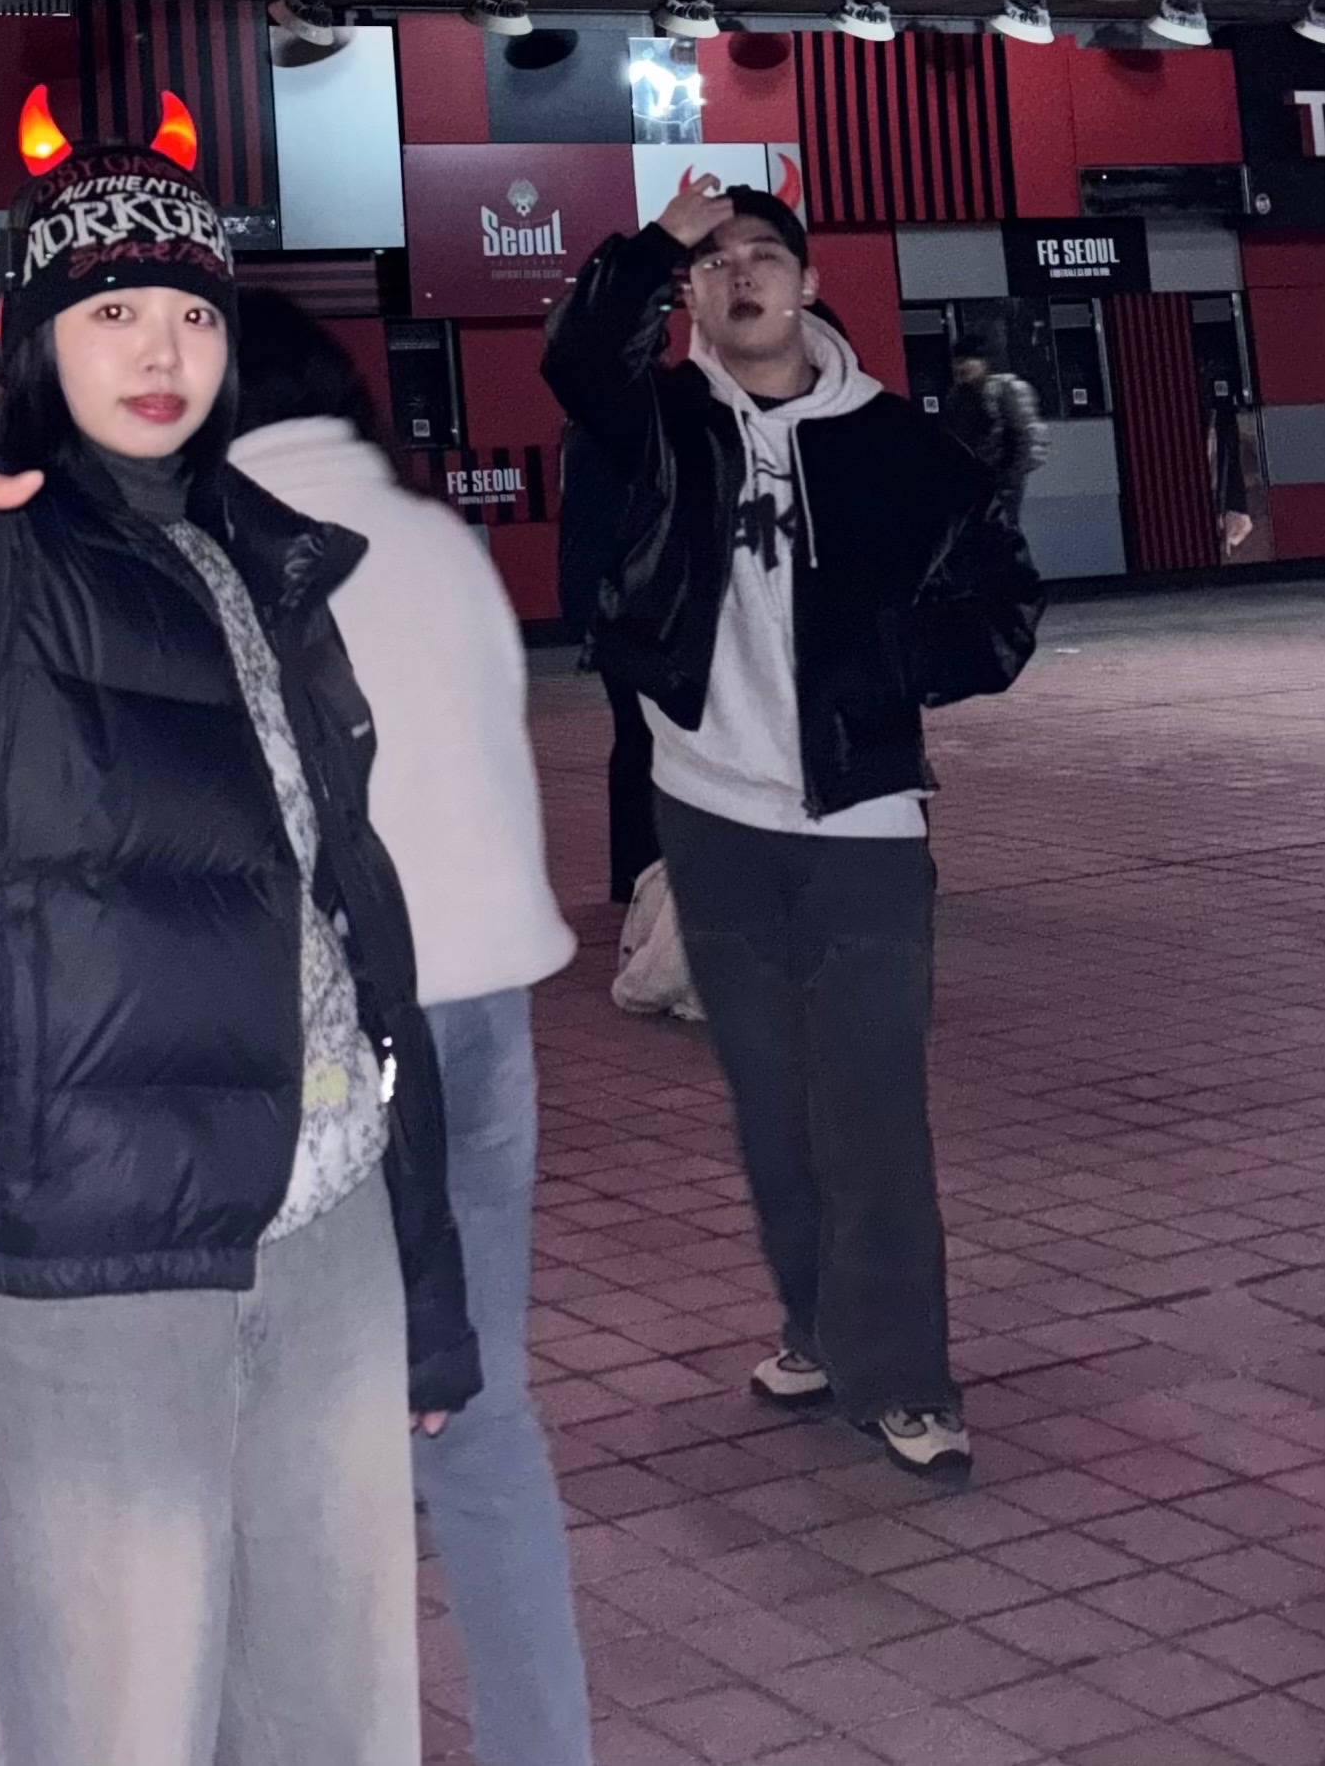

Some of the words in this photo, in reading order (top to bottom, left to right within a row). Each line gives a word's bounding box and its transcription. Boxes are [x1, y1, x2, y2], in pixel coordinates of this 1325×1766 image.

[481, 205, 567, 256] Seoul
[1036, 239, 1060, 266] FC
[1063, 238, 1121, 265] SEOUL
[446, 470, 469, 494] FC
[471, 468, 526, 493] SEOUL
